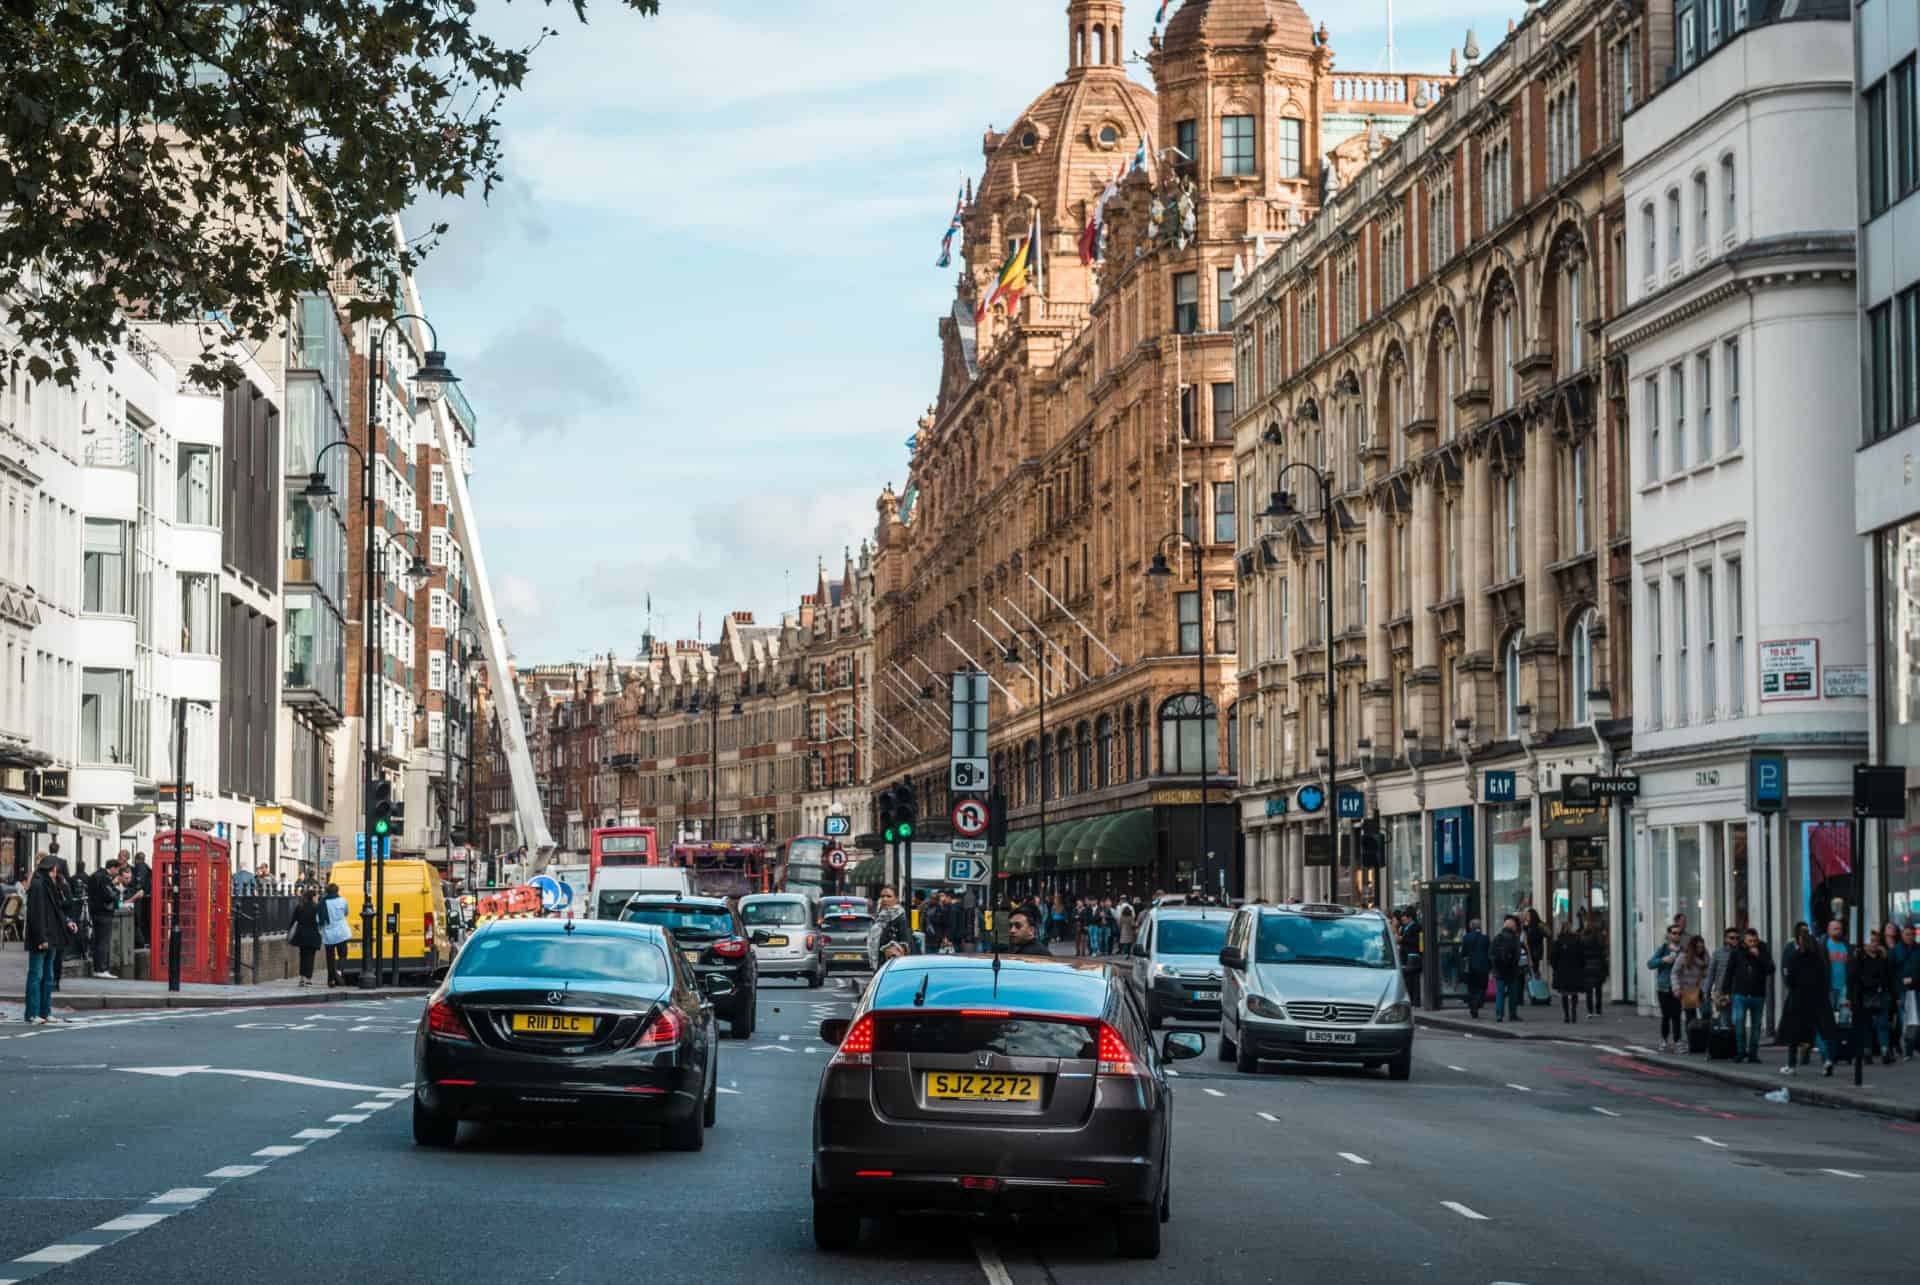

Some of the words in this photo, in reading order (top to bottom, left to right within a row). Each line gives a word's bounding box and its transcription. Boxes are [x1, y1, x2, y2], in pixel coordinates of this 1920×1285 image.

[1769, 648, 1780, 656] TO
[1781, 647, 1797, 656] LET
[44, 776, 66, 787] PAUL
[1489, 778, 1511, 794] GAP
[1591, 782, 1637, 793] PINKO
[1342, 798, 1360, 812] GAP
[955, 862, 967, 876] P
[552, 1016, 580, 1030] DLC
[936, 1075, 974, 1093] SJZ
[980, 1076, 1032, 1096] 2272
